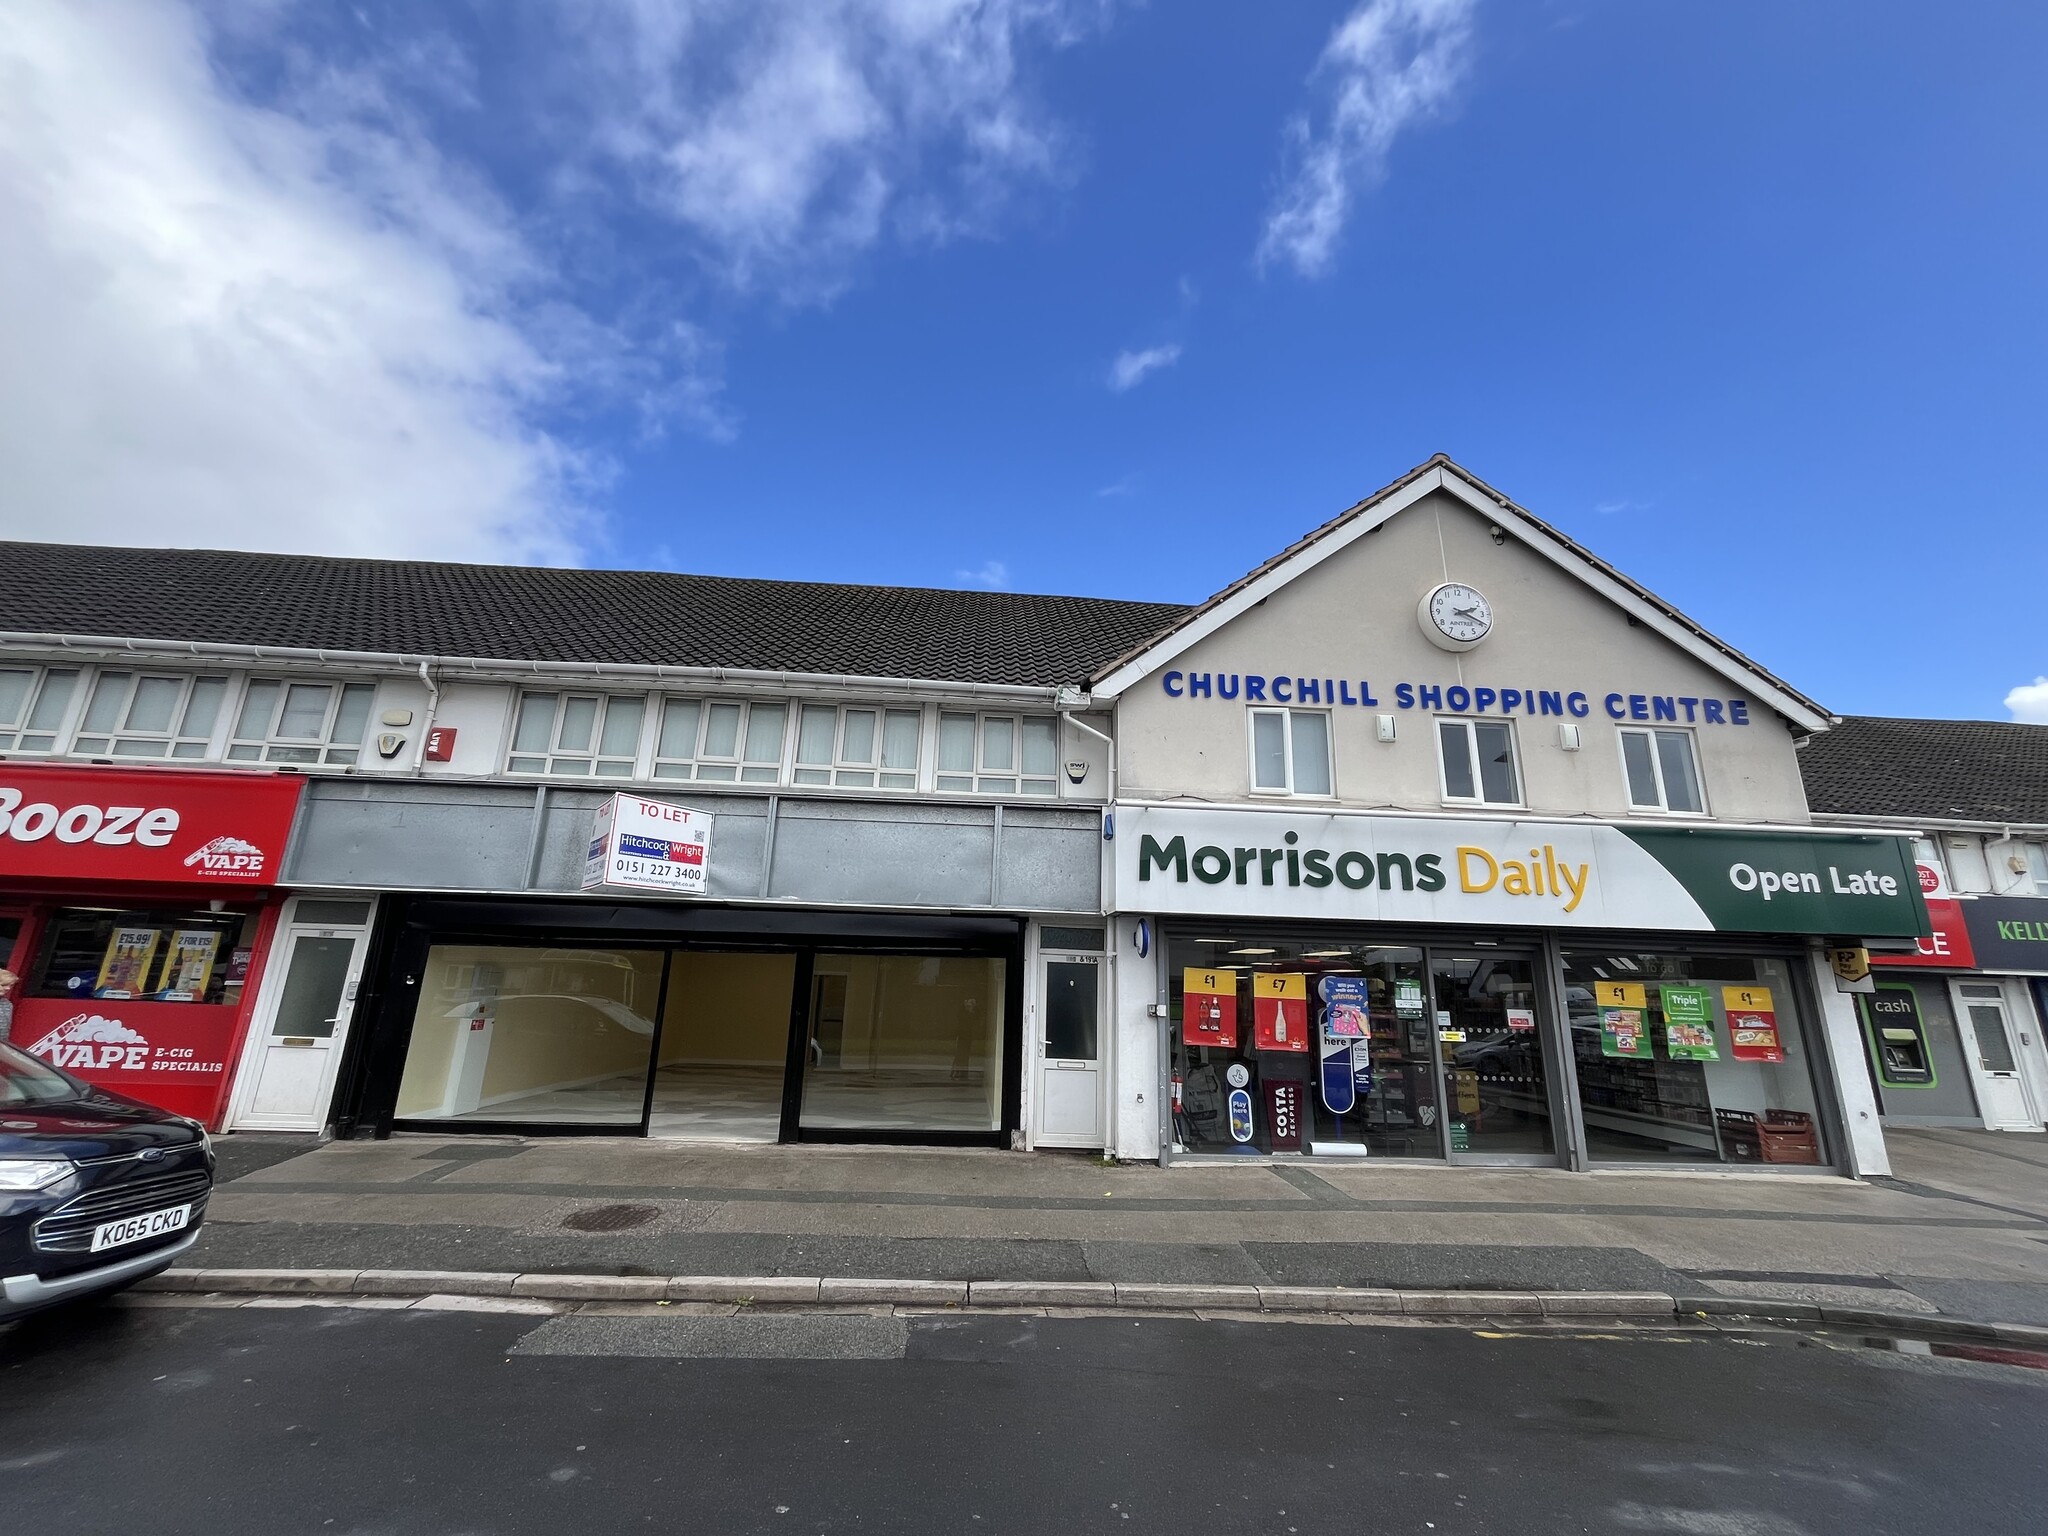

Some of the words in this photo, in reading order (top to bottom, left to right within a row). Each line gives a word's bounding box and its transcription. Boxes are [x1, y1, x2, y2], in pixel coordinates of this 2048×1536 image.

[1454, 589, 1462, 597] 12
[1449, 626, 1454, 635] 7
[1471, 627, 1476, 635] 5
[1162, 671, 1378, 706] CHURCHILL
[1395, 683, 1590, 718] SHOPPING
[1604, 693, 1750, 725] CENTRE
[639, 802, 659, 818] TO
[663, 808, 691, 824] LET
[621, 834, 670, 851] Hitchcock
[663, 851, 670, 860] &
[671, 842, 702, 857] Wright
[203, 854, 265, 870] VAPE
[616, 859, 645, 874] 0151
[650, 863, 672, 876] 227
[674, 866, 701, 881] 3400
[1138, 830, 1447, 892] Morrisons
[1456, 845, 1589, 913] Daily
[623, 875, 696, 888] www.hitchcockwright.co.uk
[1729, 862, 1821, 901] Open
[1828, 866, 1898, 897] Late
[118, 933, 152, 945] £15.99!
[178, 936, 184, 944] 2
[184, 936, 198, 945] FOR
[1205, 974, 1216, 988] £1
[1272, 978, 1287, 992] £7
[1613, 987, 1625, 1001] £1
[1671, 994, 1698, 1007] Triple
[1741, 992, 1752, 1006] £1
[1875, 998, 1911, 1013] cash
[1324, 1036, 1347, 1046] here
[51, 1044, 150, 1070] VAPE
[155, 1047, 194, 1058] E-CIG
[151, 1061, 223, 1073] SPECIALIS
[1275, 1087, 1288, 1137] COSTA
[1288, 1087, 1296, 1130] EXPRESS
[151, 1209, 183, 1232] CKD
